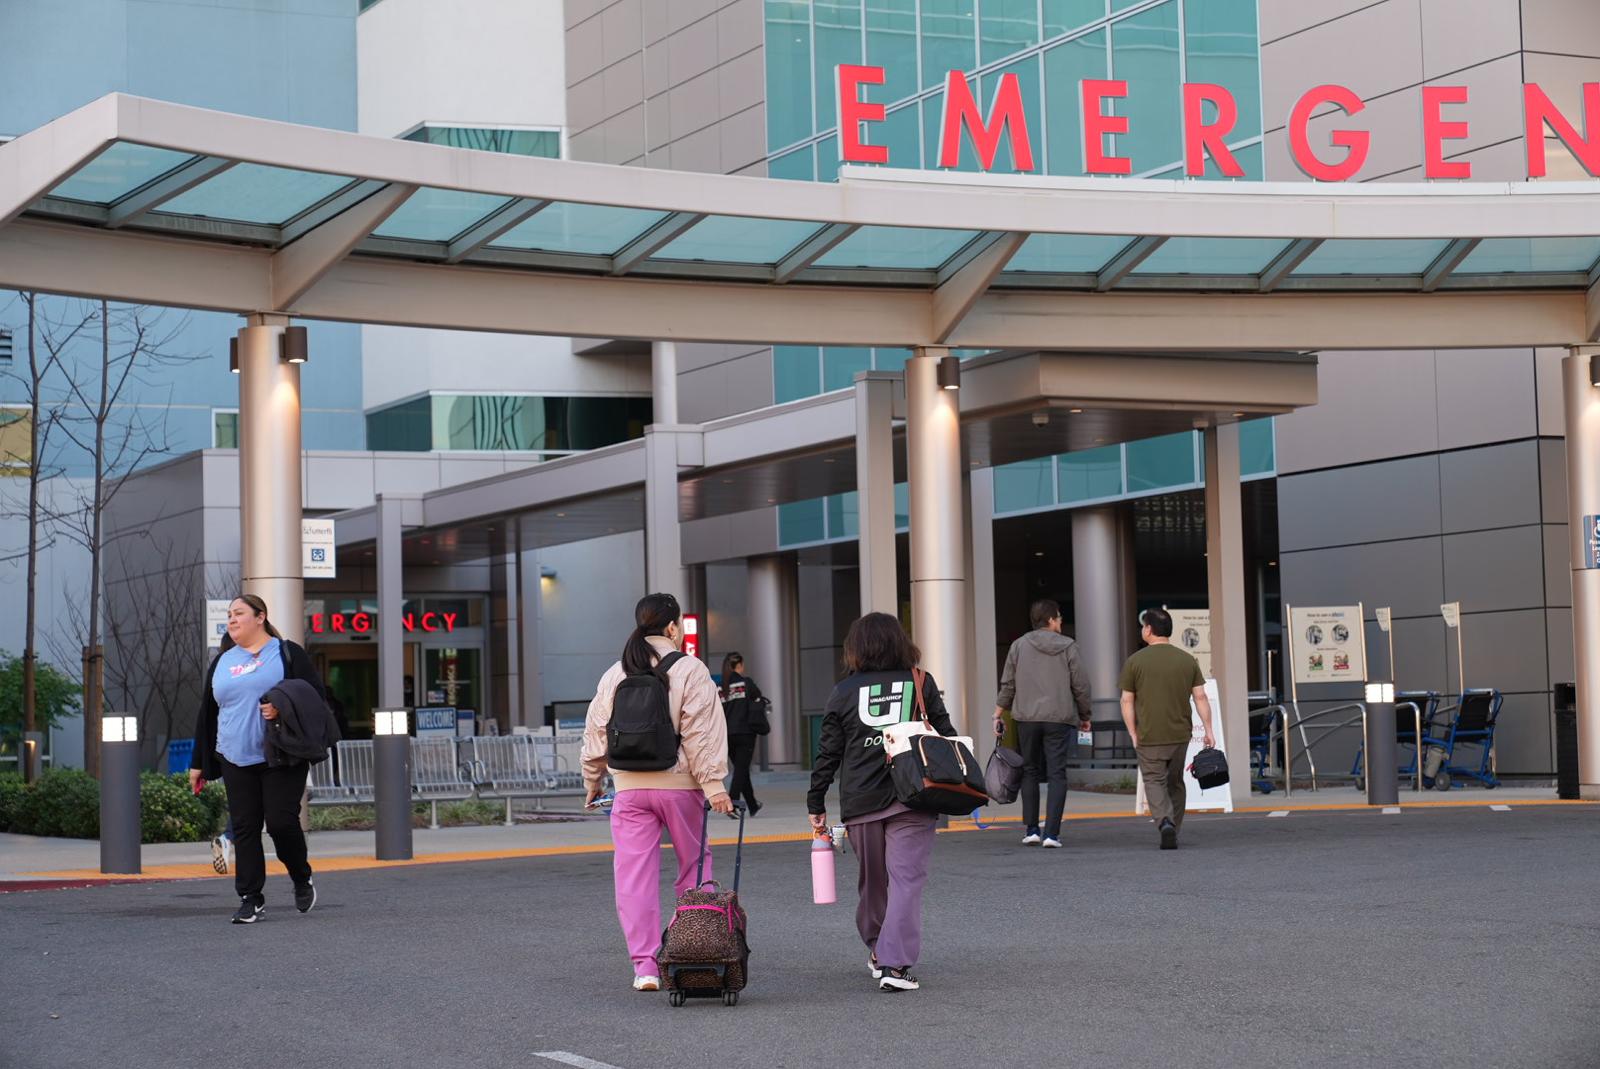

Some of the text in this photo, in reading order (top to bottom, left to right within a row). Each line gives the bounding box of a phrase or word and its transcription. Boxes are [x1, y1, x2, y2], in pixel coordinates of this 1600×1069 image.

[835, 64, 1600, 182] EMERGEN
[312, 612, 456, 632] ERGNCY
[417, 711, 454, 728] WELCOME
